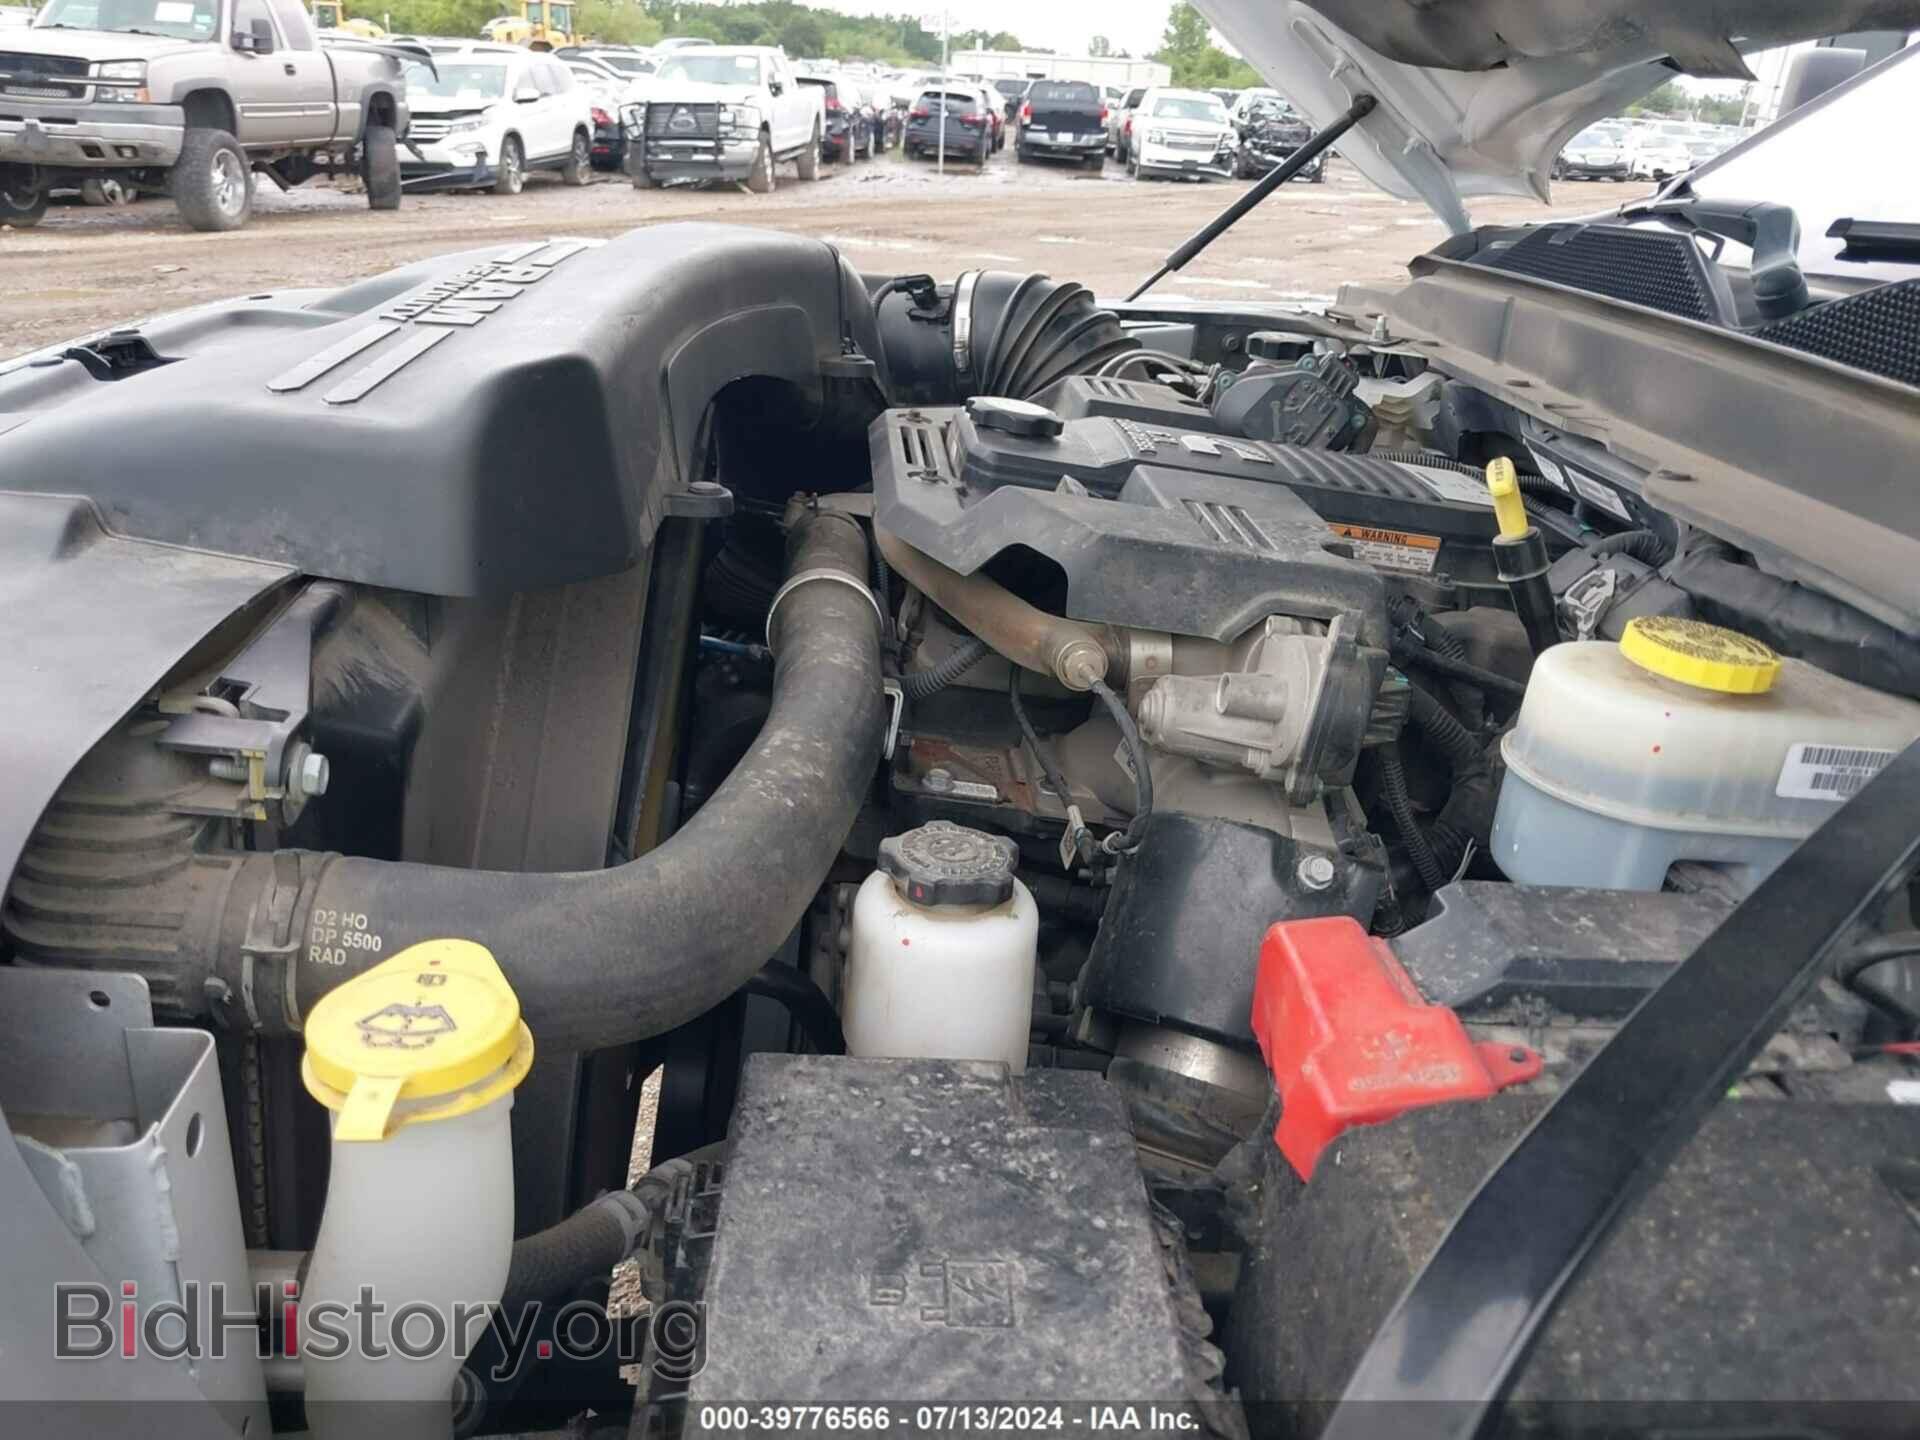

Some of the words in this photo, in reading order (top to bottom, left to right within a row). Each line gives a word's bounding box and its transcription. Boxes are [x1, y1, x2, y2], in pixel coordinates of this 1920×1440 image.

[414, 265, 554, 328] RAM
[1361, 527, 1409, 545] WARNING
[314, 909, 337, 926] D2
[342, 911, 368, 930] HO
[342, 930, 382, 952] 5500
[309, 945, 347, 966] RAD
